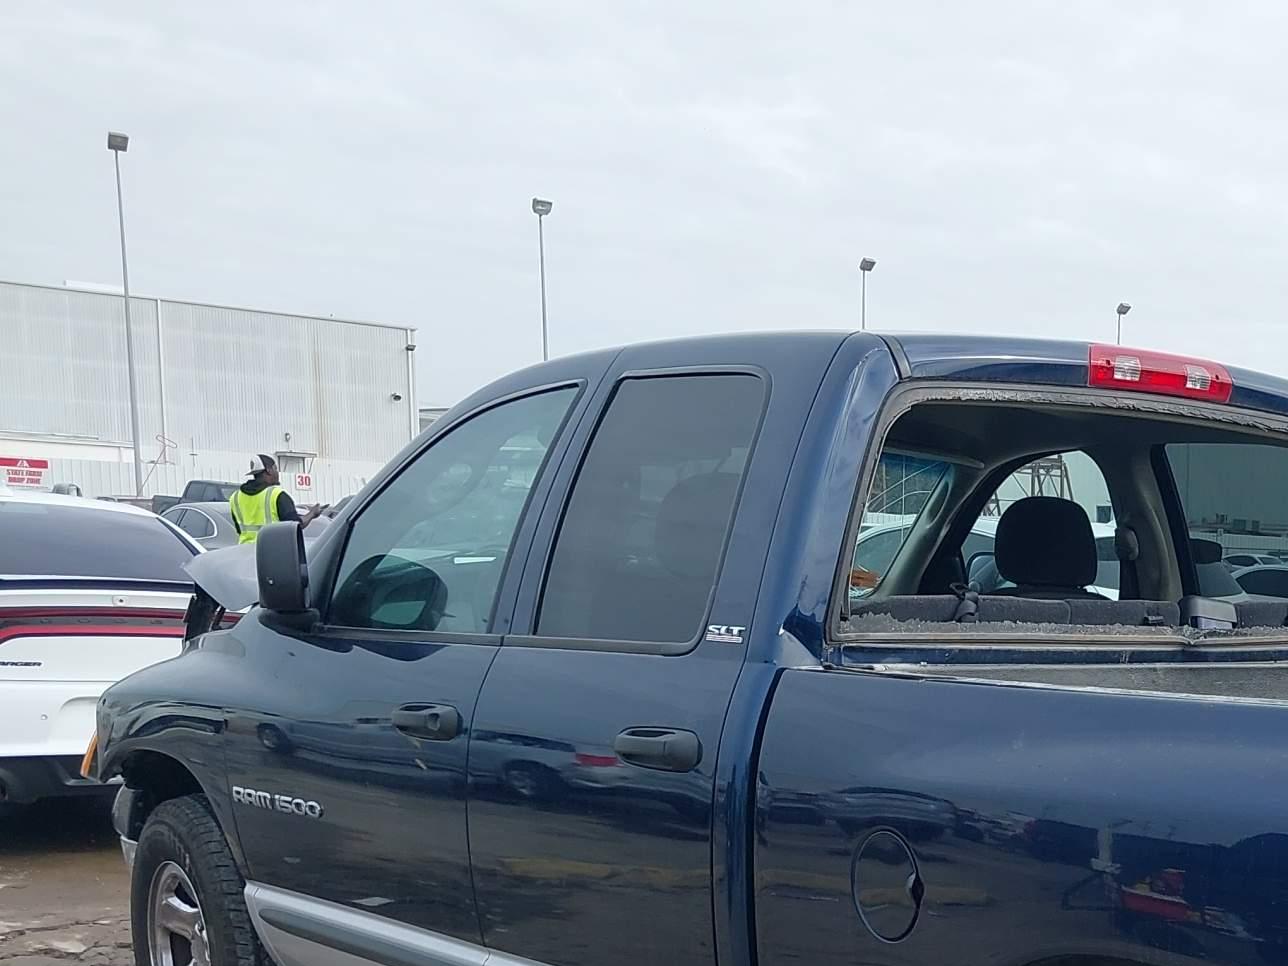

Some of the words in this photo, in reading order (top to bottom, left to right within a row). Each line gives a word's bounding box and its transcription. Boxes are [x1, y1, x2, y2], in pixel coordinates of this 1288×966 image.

[297, 475, 311, 487] 30
[708, 625, 746, 636] SLT
[232, 785, 273, 810] RAM
[274, 794, 322, 819] 1500
